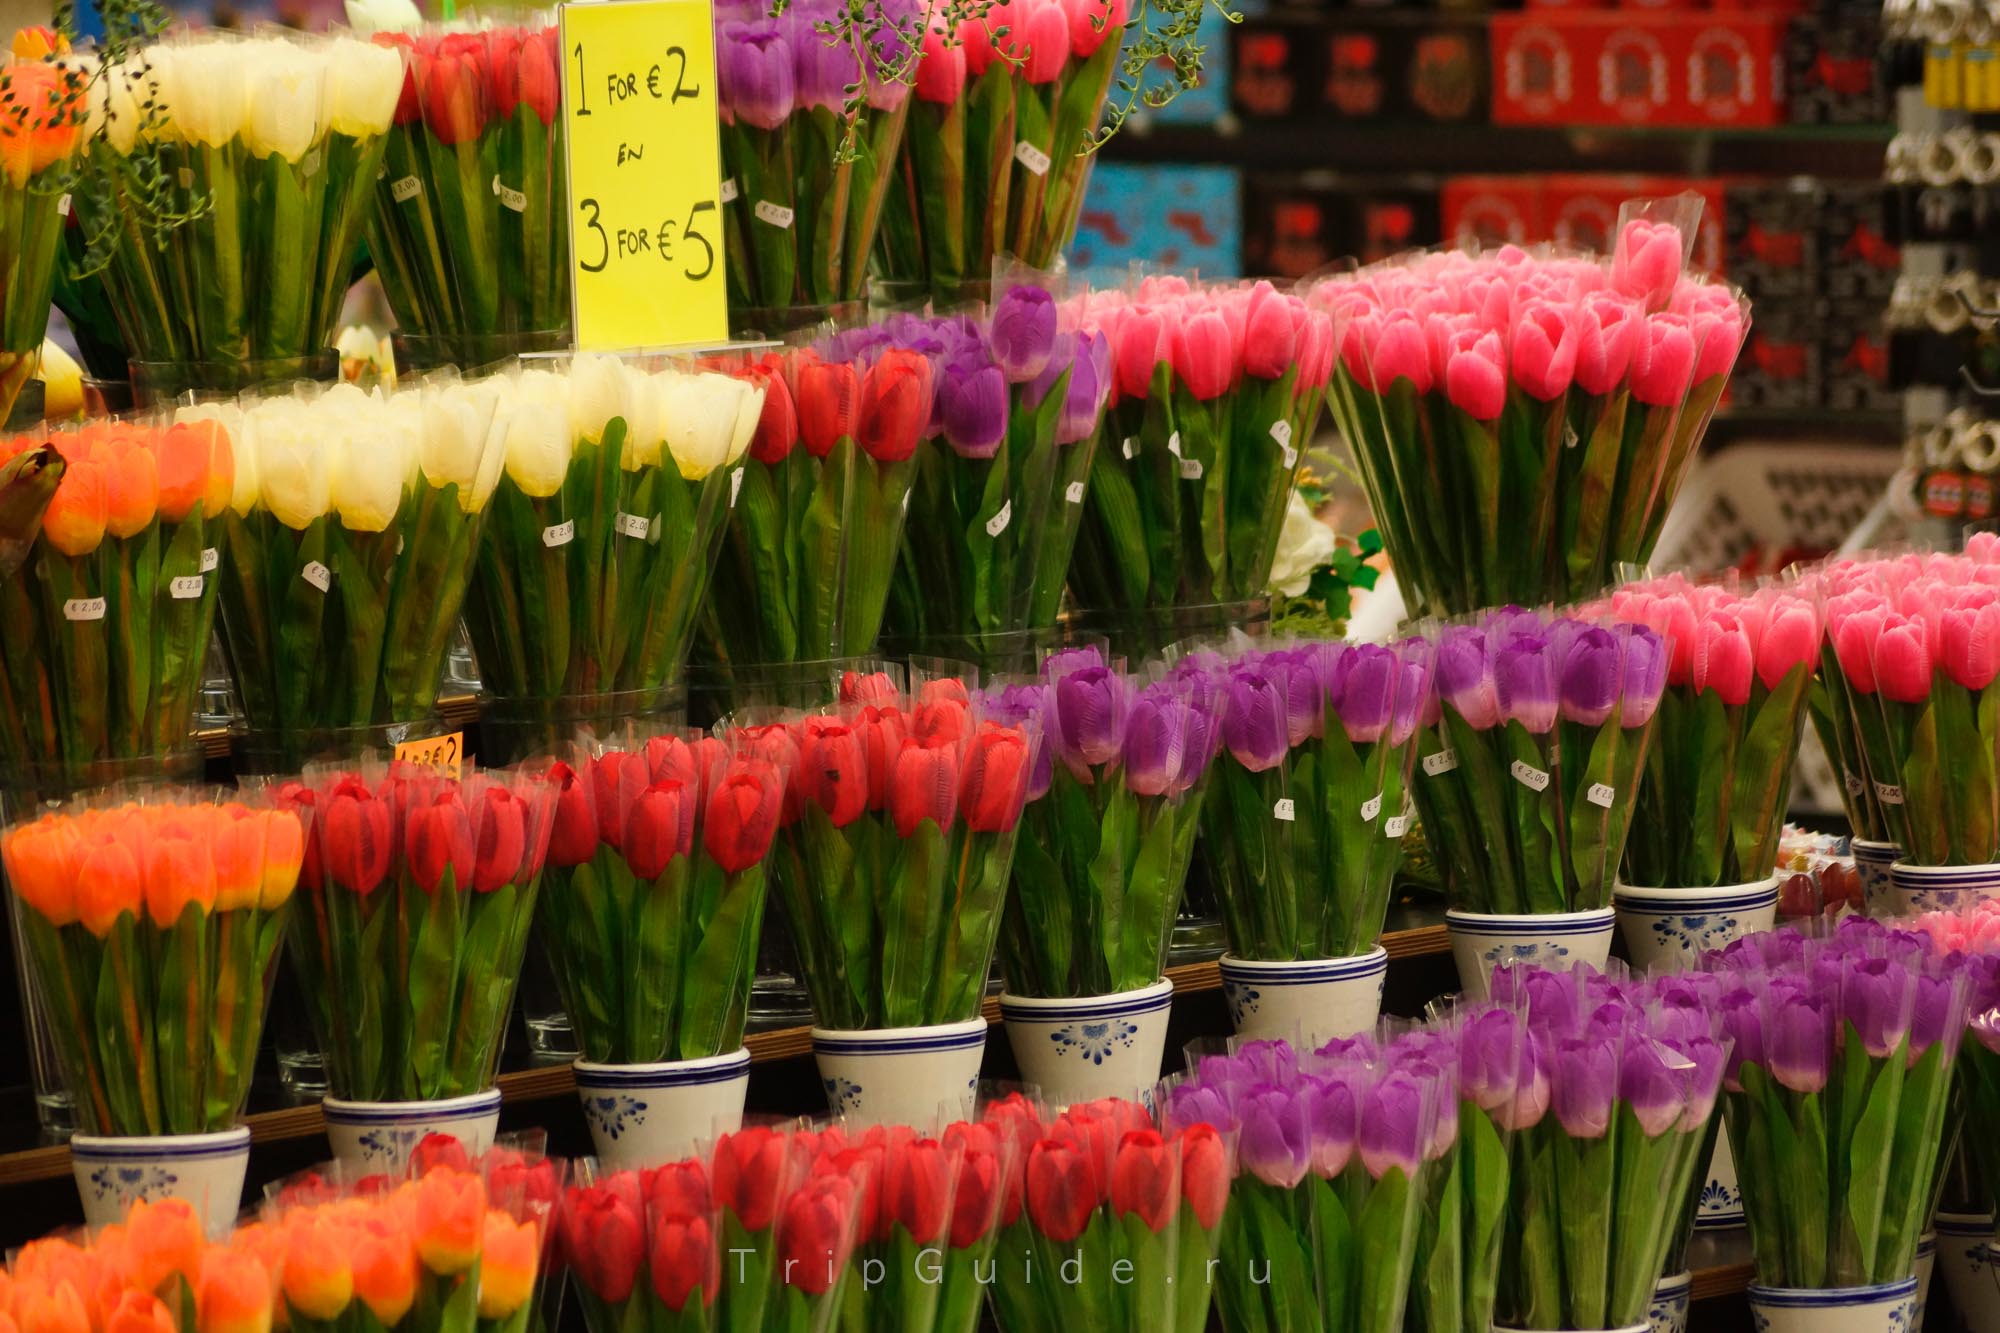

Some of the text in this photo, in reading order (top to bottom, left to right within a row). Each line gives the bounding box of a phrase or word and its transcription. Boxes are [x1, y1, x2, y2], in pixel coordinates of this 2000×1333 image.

[574, 41, 592, 116] 1
[607, 73, 638, 105] FOR
[616, 142, 644, 167] EN
[580, 198, 609, 273] 3
[617, 227, 651, 259] FOR
